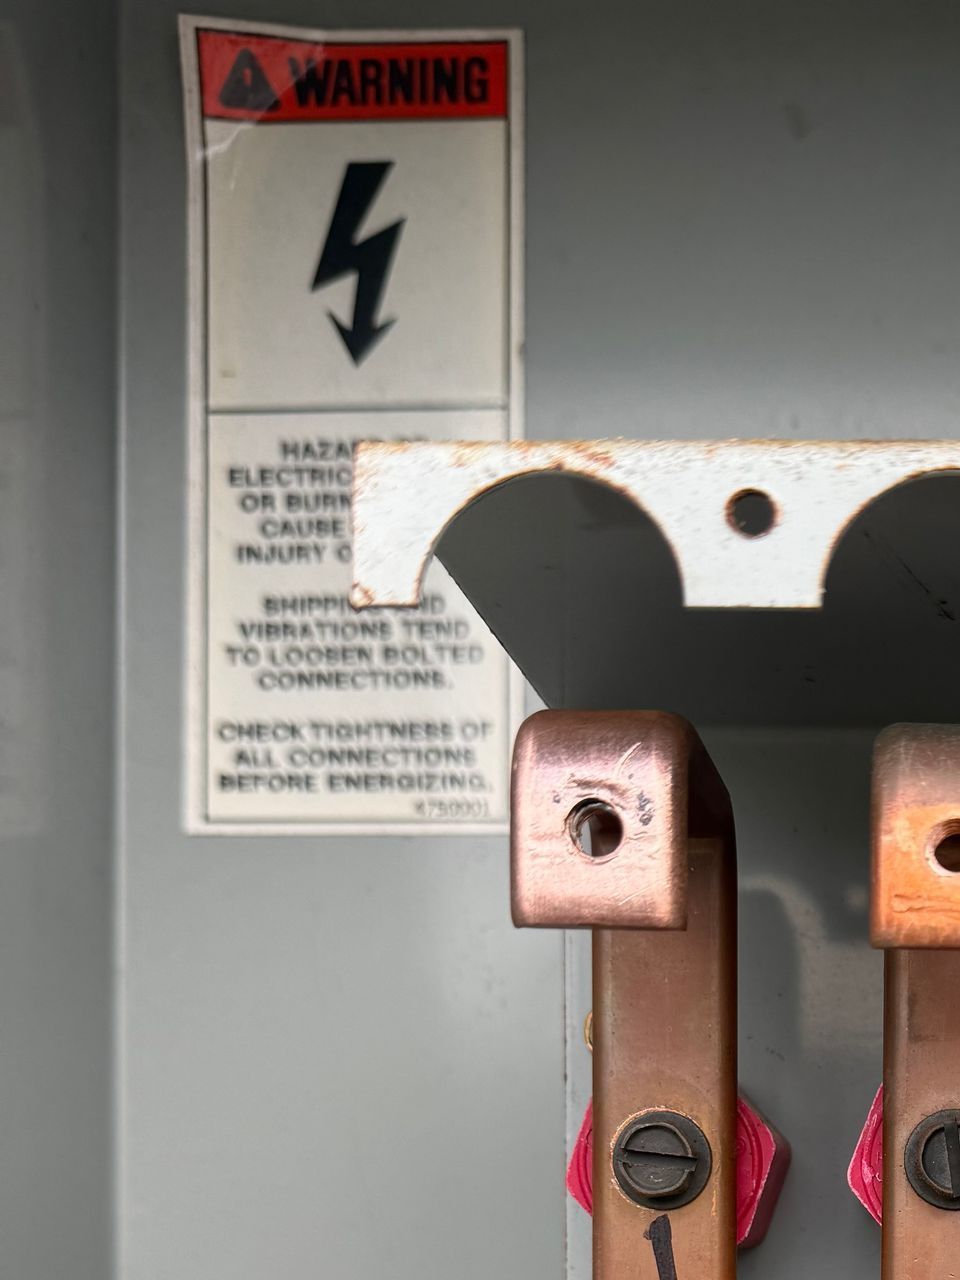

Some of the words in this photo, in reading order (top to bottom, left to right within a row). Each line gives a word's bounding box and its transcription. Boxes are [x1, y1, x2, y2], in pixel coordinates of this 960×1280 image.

[288, 56, 489, 107] WARNING
[280, 440, 353, 463] HAZA
[240, 493, 276, 514] OR
[261, 518, 346, 539] CAUSE
[236, 544, 325, 565] INJURY
[337, 543, 353, 564] O
[238, 620, 393, 642] VIBRATIONS
[402, 620, 469, 641] TEND
[226, 646, 260, 667] TO
[271, 646, 372, 667] LOOSEN
[381, 646, 484, 666] BOLTED
[258, 670, 455, 691] CONNECTIONS.
[217, 721, 306, 743] CHECK
[310, 721, 453, 742] TIGHTNESS
[461, 719, 493, 741] OF
[235, 747, 280, 768] ALL
[288, 746, 477, 768] CONNECTIONS
[219, 773, 319, 794] BEFORE
